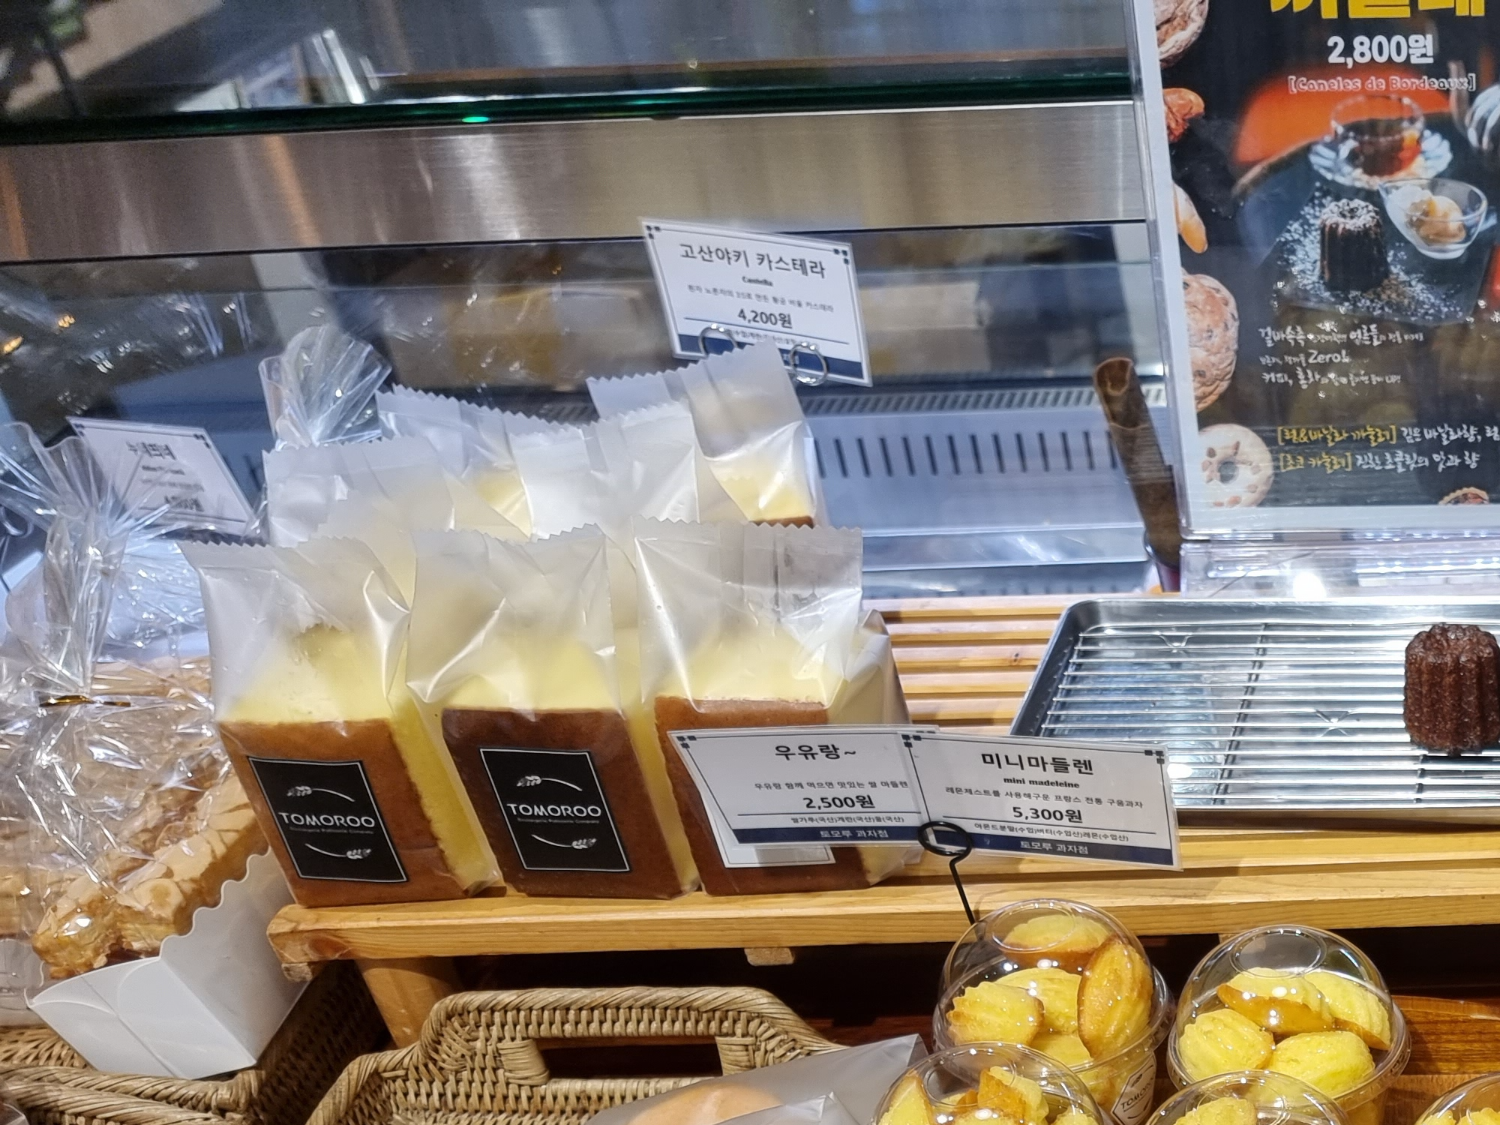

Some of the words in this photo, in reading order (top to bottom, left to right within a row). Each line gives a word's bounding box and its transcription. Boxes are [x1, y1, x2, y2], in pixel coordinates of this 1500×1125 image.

[1327, 34, 1434, 69] 2,800원
[1365, 76, 1385, 91] de
[679, 243, 750, 268] 고산야키
[756, 253, 826, 279] 카스테라
[738, 308, 793, 330] 4,200원
[775, 743, 857, 761] 우유랑~
[981, 752, 1094, 776] 미니마들렌
[785, 781, 804, 790] 함께
[806, 781, 834, 789] 먹으면
[837, 780, 865, 789] 맛있는
[881, 780, 909, 789] 마들렌
[1003, 776, 1026, 786] mini
[1028, 779, 1080, 789] madeleine
[803, 794, 876, 811] 2,500원
[1054, 794, 1082, 804] 프랑스
[1084, 796, 1103, 806] 전통
[506, 803, 602, 817] TOMOROO
[1012, 806, 1083, 824] 5,300원
[278, 811, 375, 828] TOMOROO
[856, 829, 889, 839] 과자점
[1056, 843, 1089, 856] 과자점
